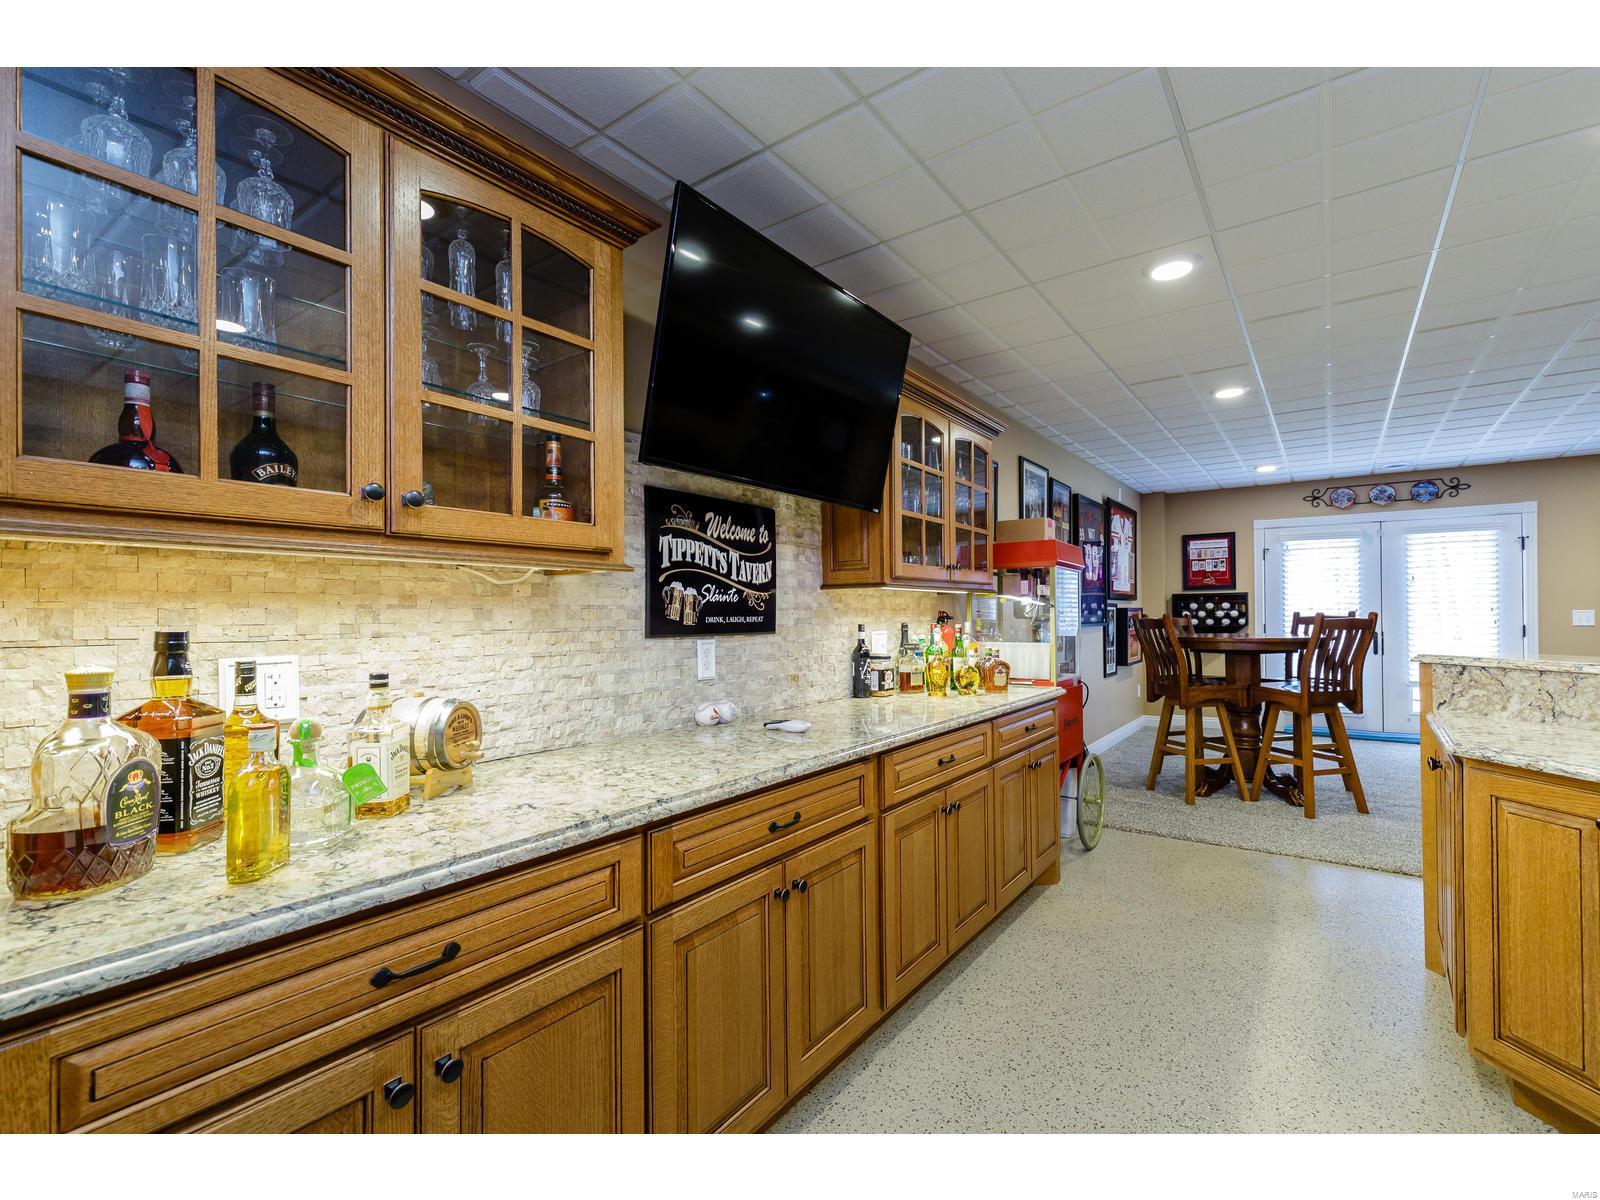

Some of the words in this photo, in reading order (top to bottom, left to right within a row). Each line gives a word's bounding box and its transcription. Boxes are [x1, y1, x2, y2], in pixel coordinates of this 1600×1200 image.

[256, 464, 297, 478] BAILEY
[705, 512, 756, 541] Welcome
[759, 524, 769, 544] to
[659, 533, 727, 574] TIPPETT'S
[729, 550, 773, 584] TAVERN
[746, 615, 764, 623] REPEAT
[187, 746, 204, 766] JACK
[195, 786, 220, 798] WHISKEY
[115, 801, 154, 819] BLACK
